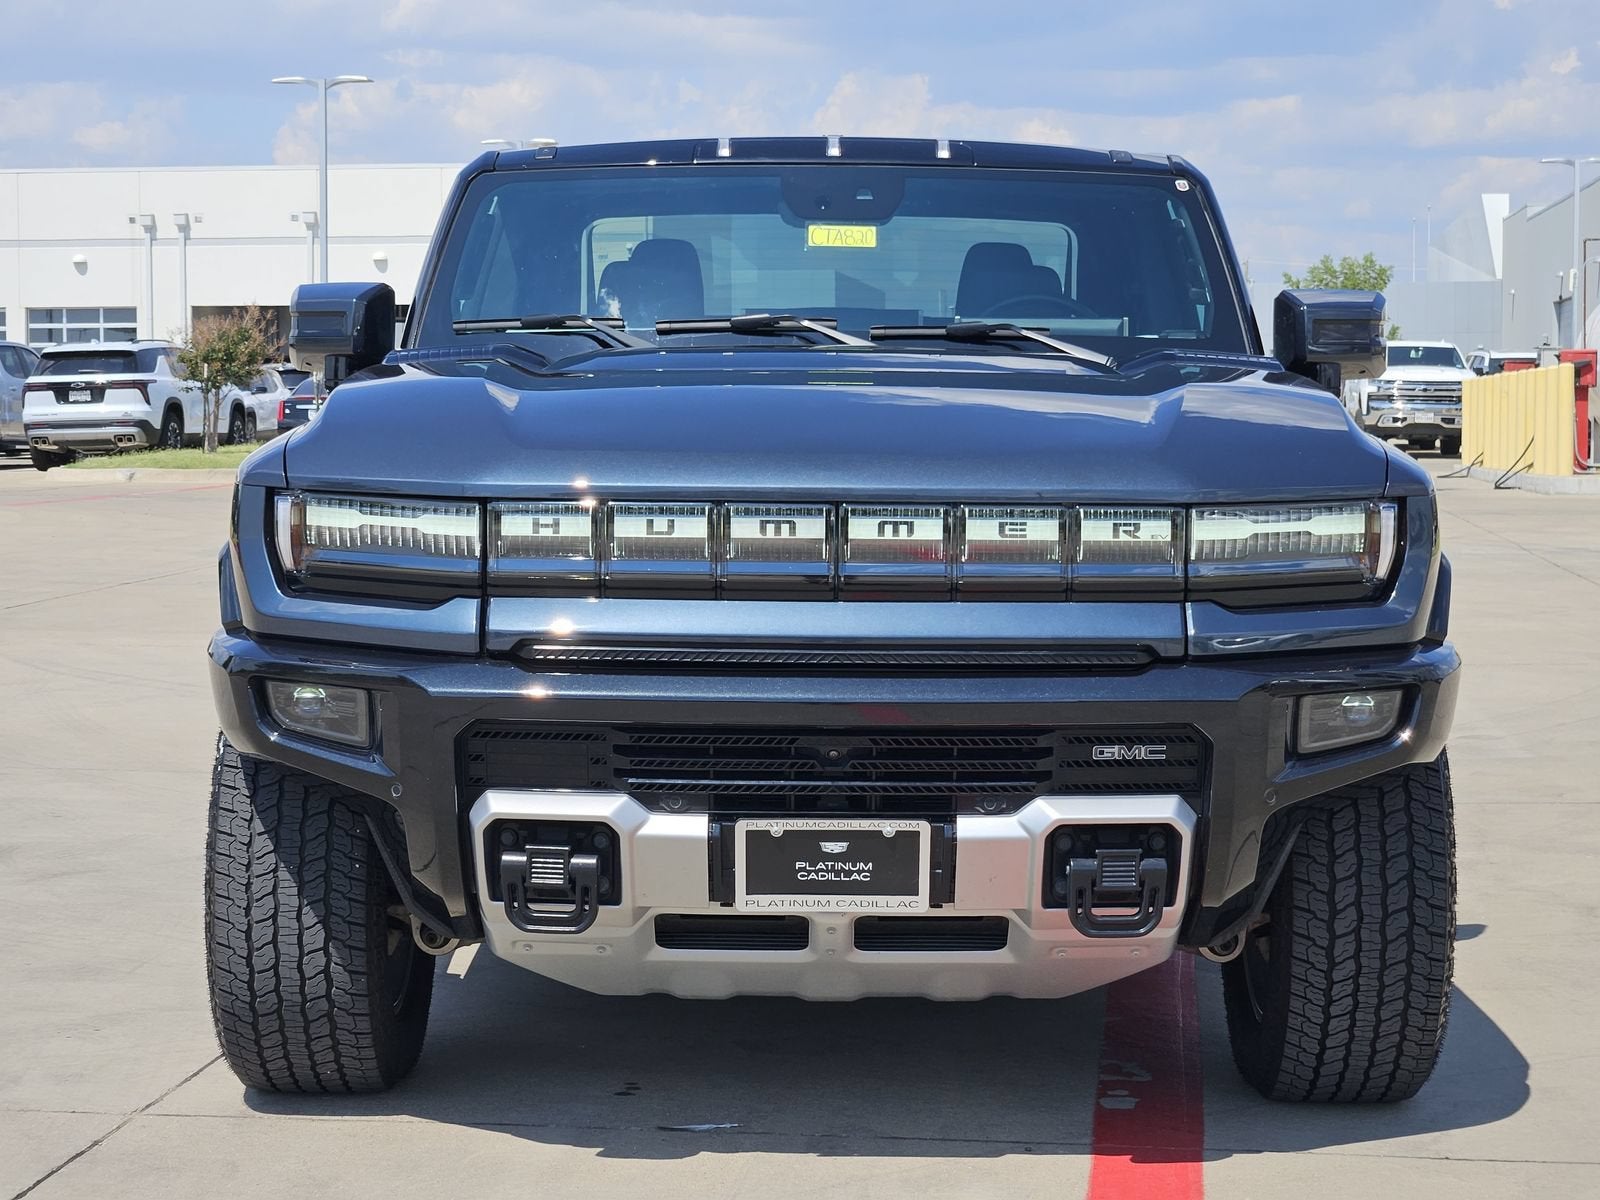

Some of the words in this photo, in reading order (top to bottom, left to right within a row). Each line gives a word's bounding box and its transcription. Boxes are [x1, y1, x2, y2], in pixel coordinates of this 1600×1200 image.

[811, 227, 874, 246] CTA820
[1092, 745, 1167, 760] GMC
[746, 821, 920, 830] PLATINUMCADILLACCOM
[795, 861, 873, 871] PLATINUM
[797, 872, 871, 881] CADILLAC
[745, 899, 831, 909] PLATINUM
[835, 899, 920, 909] CADILLAC
